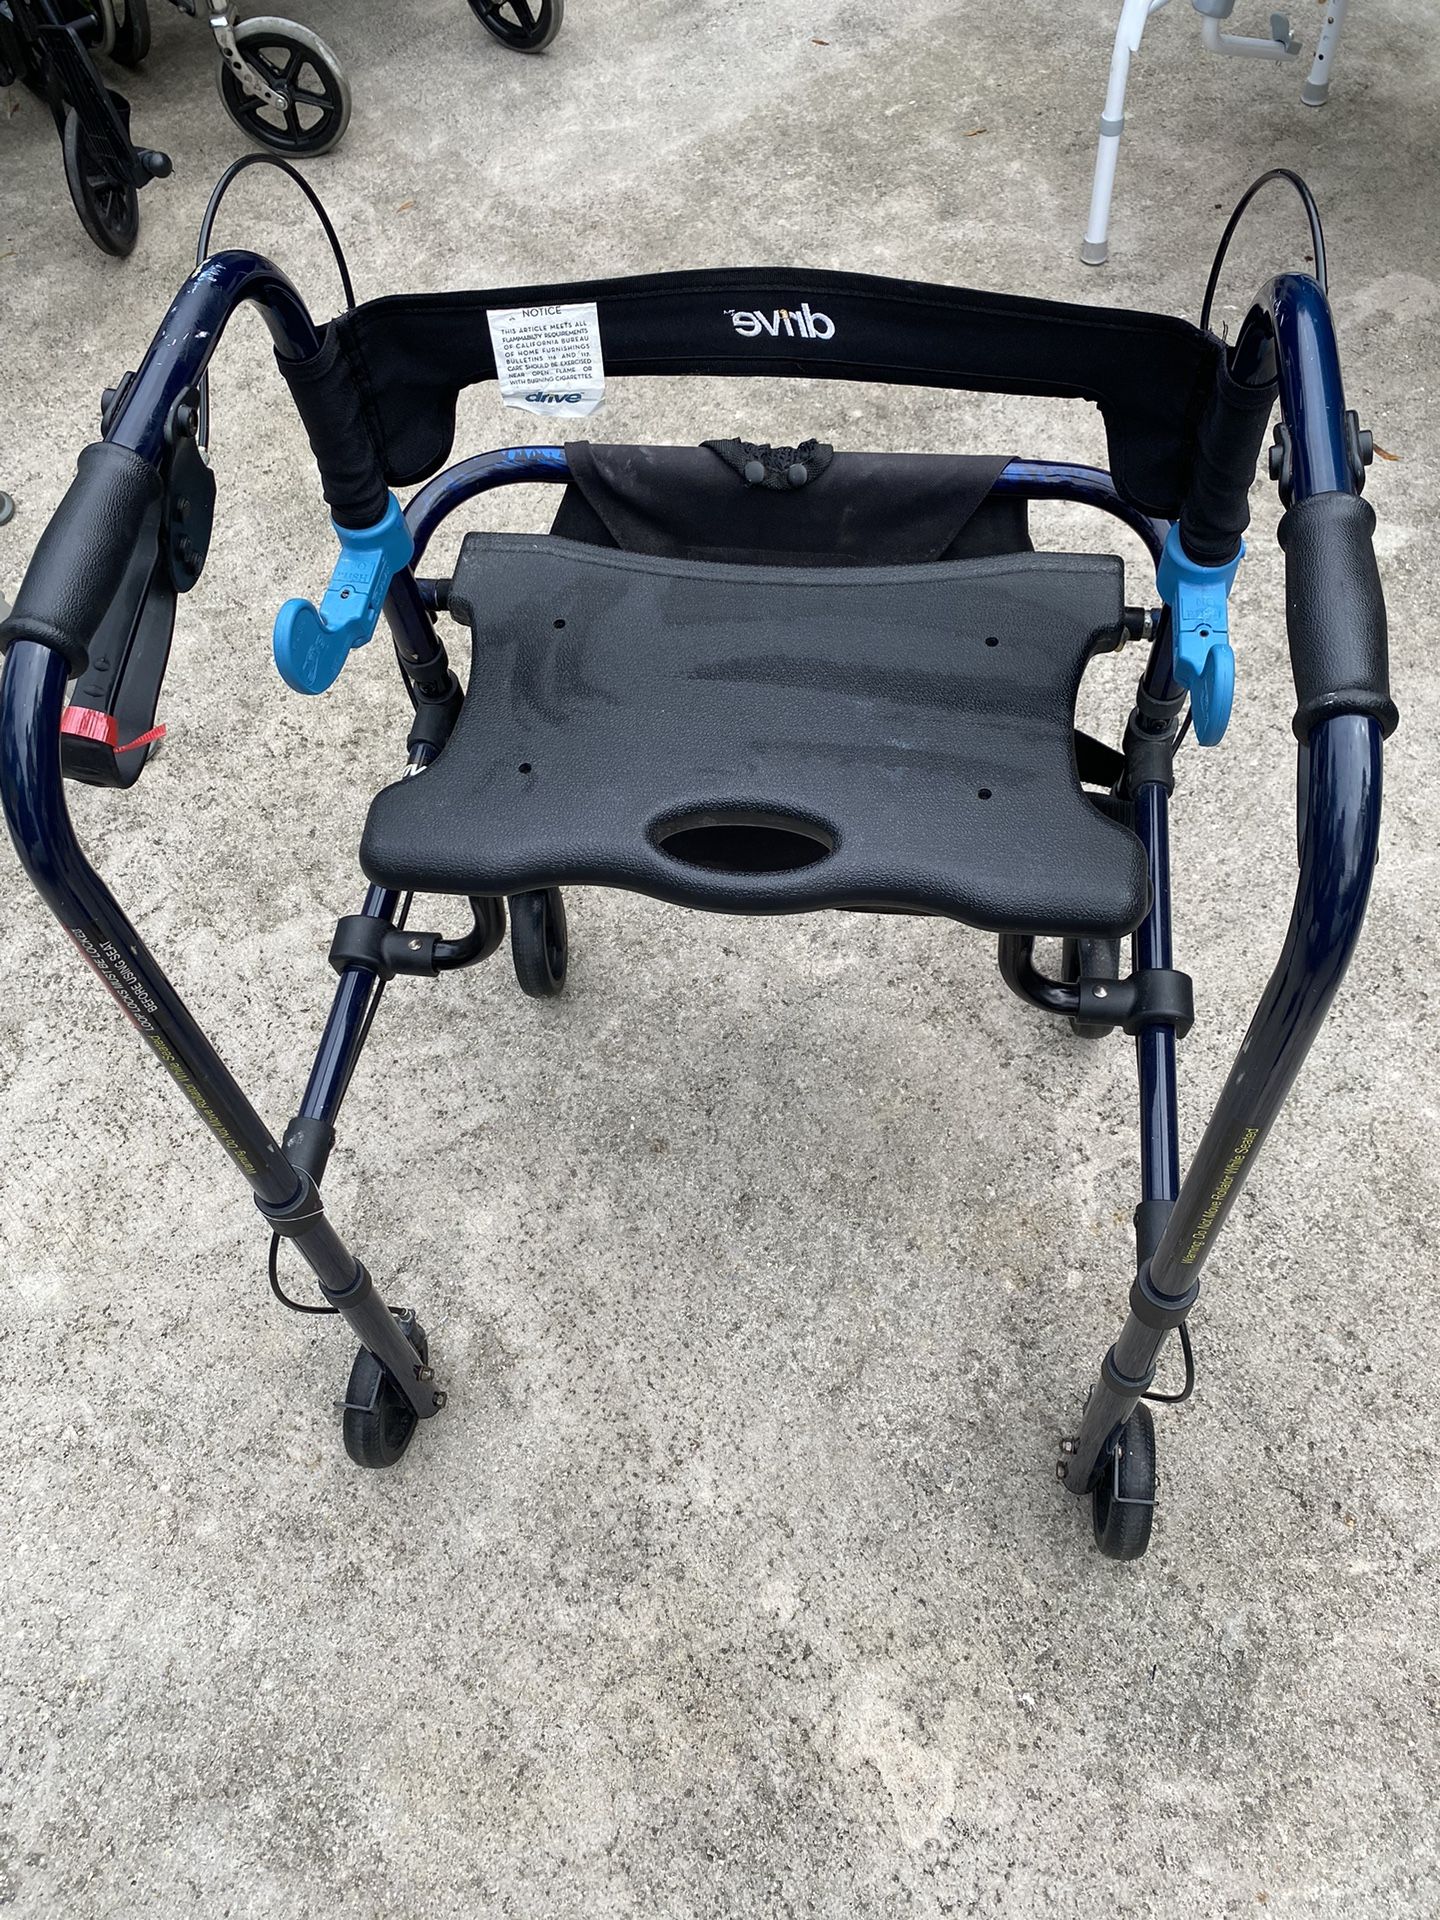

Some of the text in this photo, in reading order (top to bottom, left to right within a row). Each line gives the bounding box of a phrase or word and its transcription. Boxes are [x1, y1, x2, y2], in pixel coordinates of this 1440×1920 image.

[522, 306, 562, 318] NOTICE
[519, 325, 547, 333] ARTICLE
[550, 321, 572, 330] MEETS
[544, 328, 588, 338] REQUIREMENTS
[516, 340, 559, 349] CALIFORNIA
[561, 336, 589, 344] BUREAU
[542, 343, 590, 353] FURNISHINGS
[506, 355, 543, 364] BULLETINS
[525, 362, 549, 370] SHOULD
[560, 358, 592, 367] EXERCISED
[527, 376, 554, 384] BURNING
[555, 373, 592, 381] CIGARETTES
[525, 391, 582, 404] drive
[94, 956, 109, 969] BE
[99, 940, 158, 1014] BEFORE USING SEAT
[101, 970, 125, 990] MUST
[117, 989, 141, 1013] LOCKS
[134, 1012, 155, 1031] LOOP
[149, 1035, 175, 1061] Seated
[1234, 1128, 1259, 1154] Seated
[1211, 1175, 1233, 1202] Rollator
[1202, 1200, 1222, 1220] Move
[1197, 1217, 1213, 1231] Not
[1192, 1229, 1207, 1240] Do
